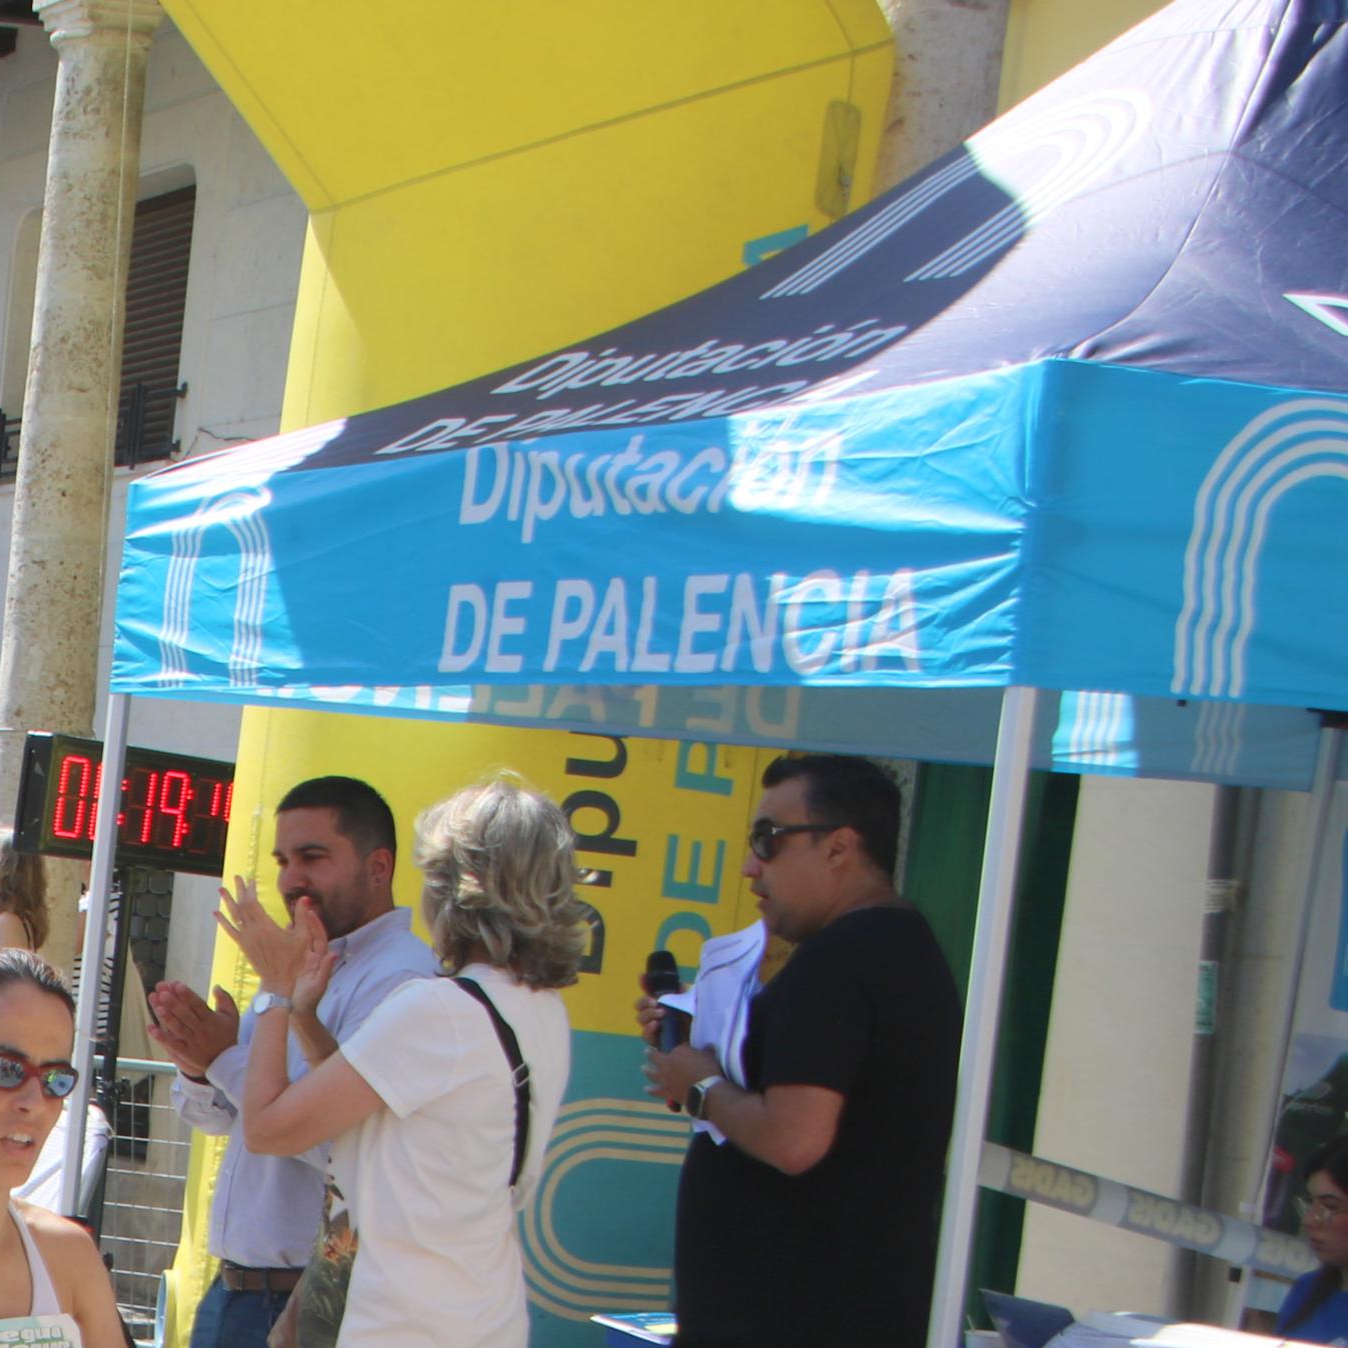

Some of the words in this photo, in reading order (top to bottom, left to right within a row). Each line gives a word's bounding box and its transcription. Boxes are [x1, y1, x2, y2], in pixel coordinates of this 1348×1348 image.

[490, 318, 906, 400] Diputación
[371, 413, 519, 455] DE
[459, 425, 844, 544] Diputación
[438, 581, 534, 673] DE
[542, 567, 922, 675] PALENCIA
